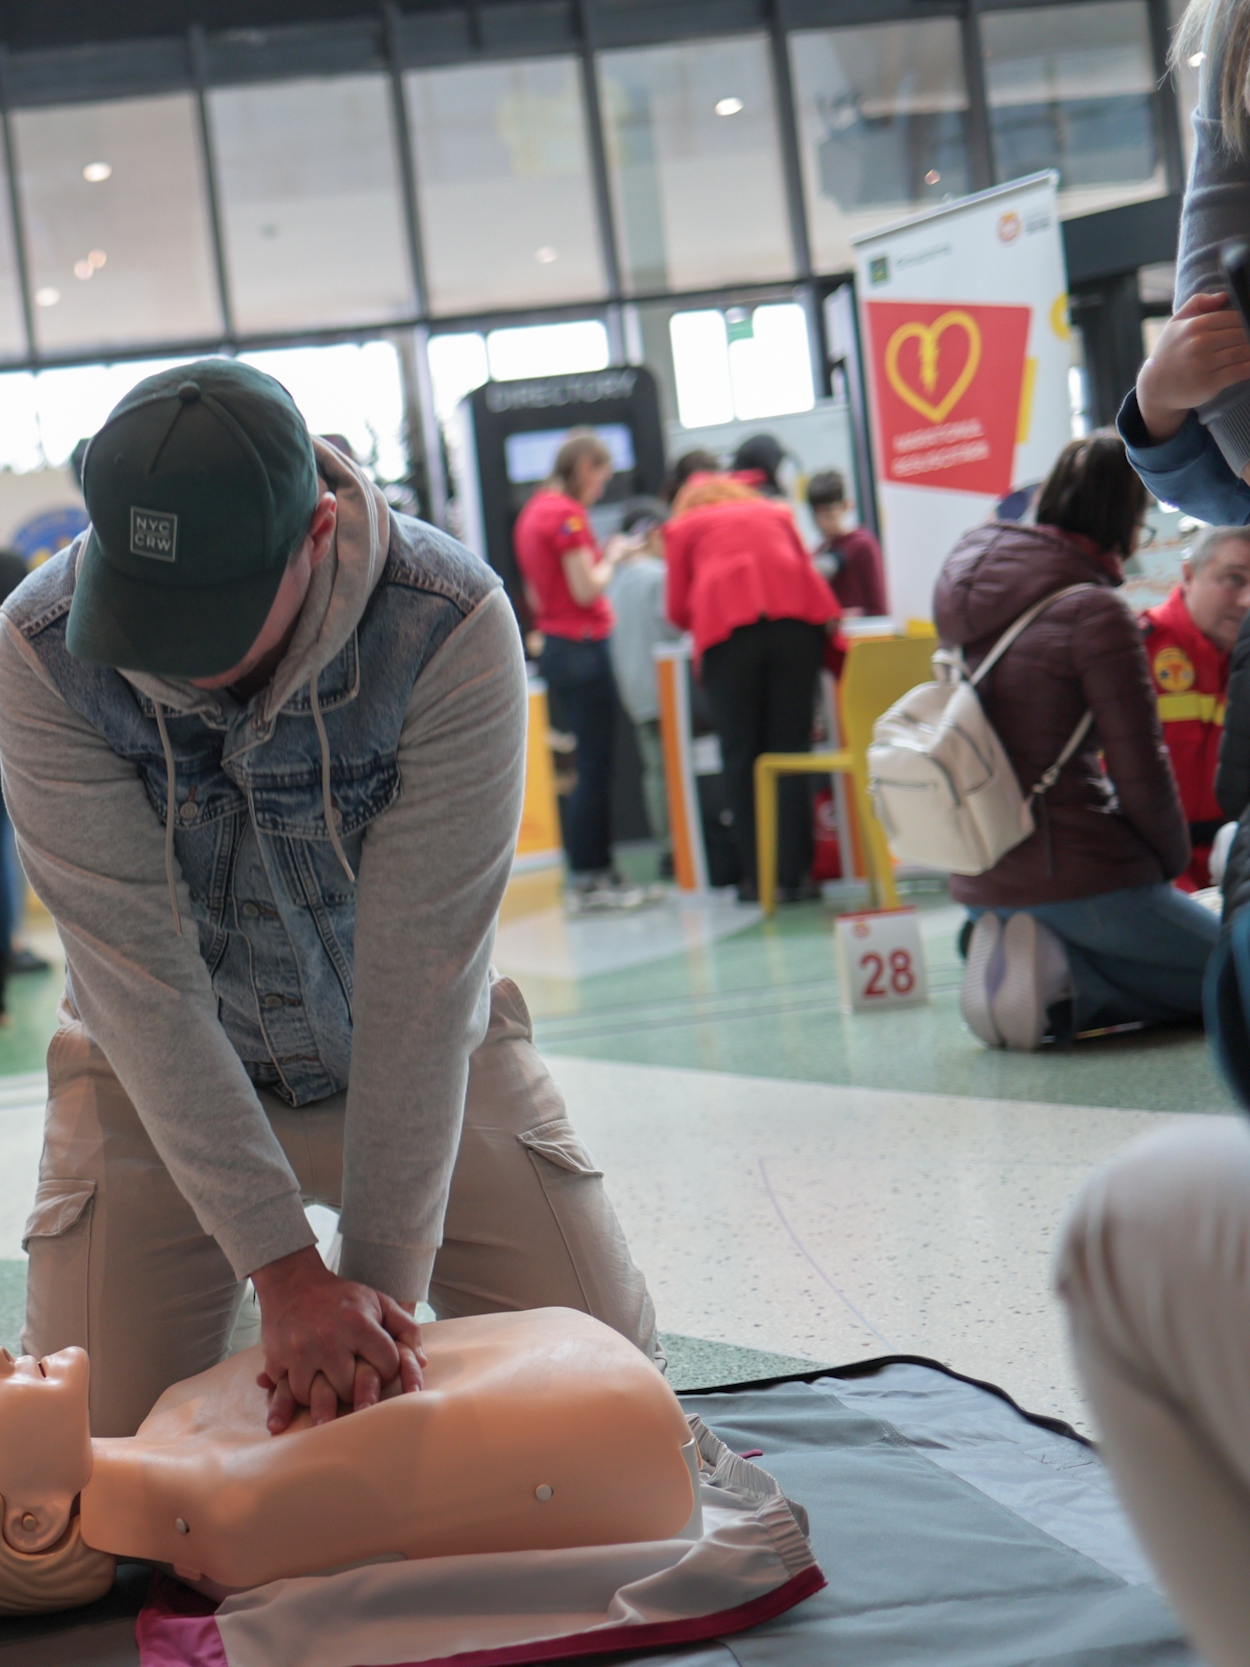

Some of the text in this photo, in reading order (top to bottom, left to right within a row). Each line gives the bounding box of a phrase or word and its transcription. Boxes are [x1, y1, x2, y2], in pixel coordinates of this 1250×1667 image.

[136, 515, 170, 535] NYC
[135, 532, 171, 552] CRW
[860, 948, 916, 998] 28
